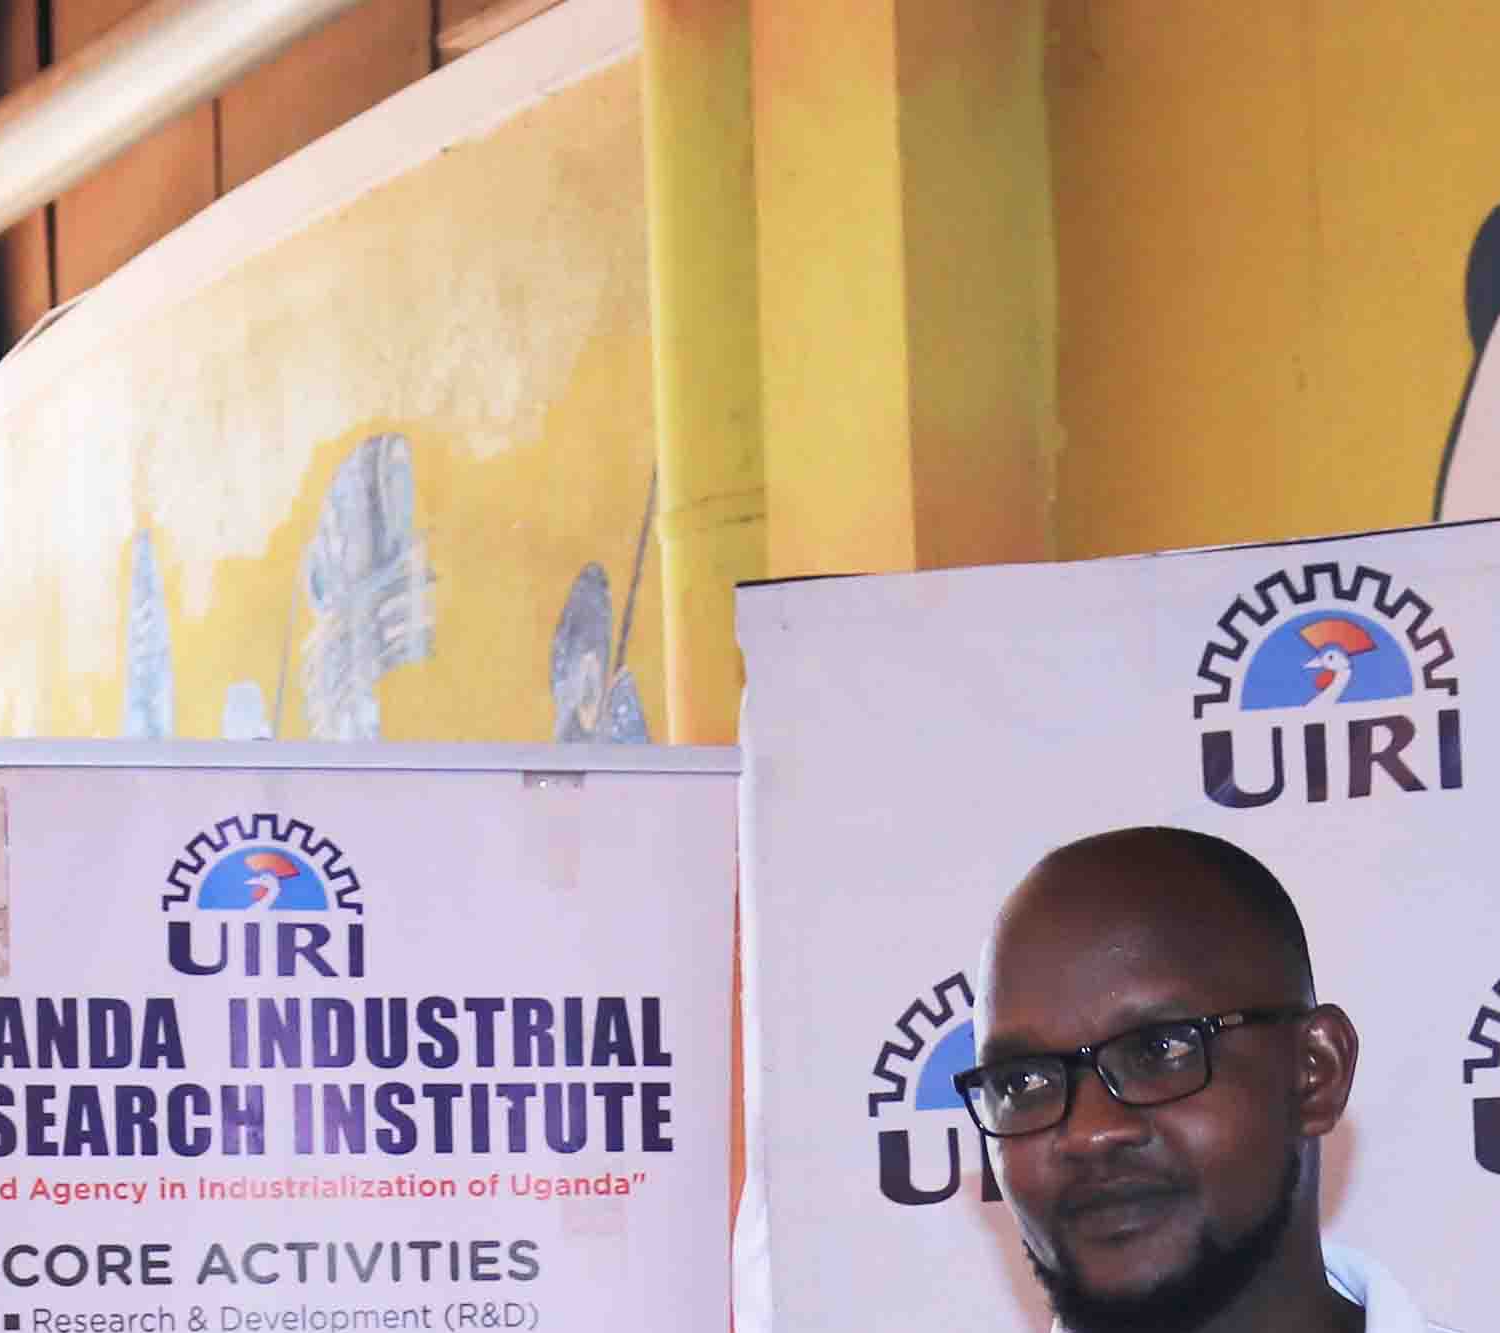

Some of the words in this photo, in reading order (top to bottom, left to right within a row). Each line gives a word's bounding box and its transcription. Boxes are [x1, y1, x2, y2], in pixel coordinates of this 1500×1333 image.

[1201, 708, 1463, 809] UIRI
[168, 921, 364, 978] UIRI
[229, 996, 672, 1069] INDUSTRIAL
[294, 1082, 673, 1155] INSTITUTE
[30, 1178, 147, 1205] Agency
[160, 1177, 186, 1200] in
[199, 1174, 457, 1200] Industrialization
[468, 1174, 499, 1197] of
[2, 1244, 172, 1287] CORE
[197, 1240, 539, 1285] ACTIVITIES
[33, 1306, 175, 1333] Research
[188, 1306, 208, 1332] &
[220, 1304, 432, 1333] Development
[444, 1302, 538, 1332] (R&D)
